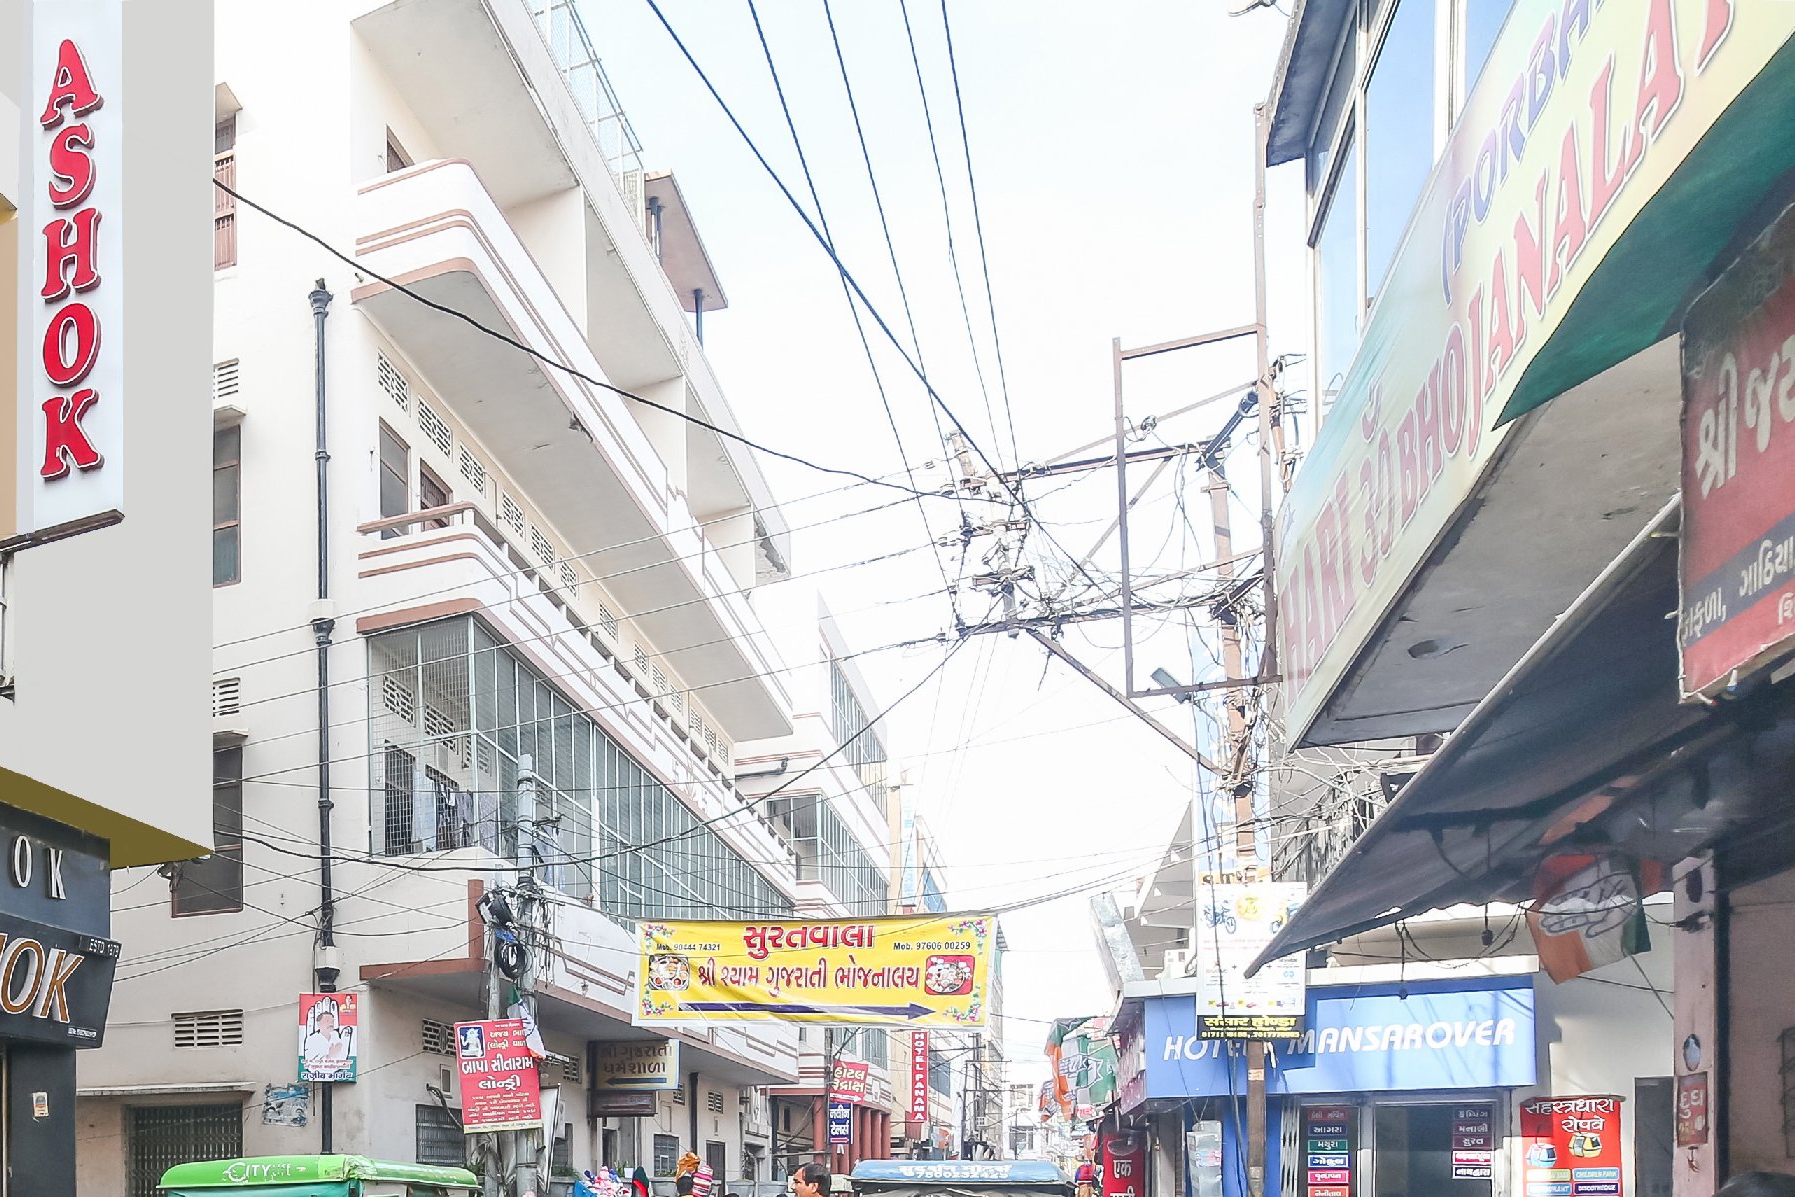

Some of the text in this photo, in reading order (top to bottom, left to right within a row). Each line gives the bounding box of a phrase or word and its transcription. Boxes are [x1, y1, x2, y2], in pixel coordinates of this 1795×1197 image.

[40, 38, 105, 482] ASHOK
[1281, 469, 1354, 710] HARI
[743, 925, 875, 960] સુરતવાલા
[893, 942, 913, 951] Mob.
[698, 957, 716, 987] શ્રી
[765, 957, 828, 998] ગુજરાતી
[834, 954, 920, 989] ભોજનાલય
[1287, 1017, 1517, 1055] MANSAROVER
[914, 1073, 925, 1120] PANAMA
[1113, 1158, 1133, 1180] एक
